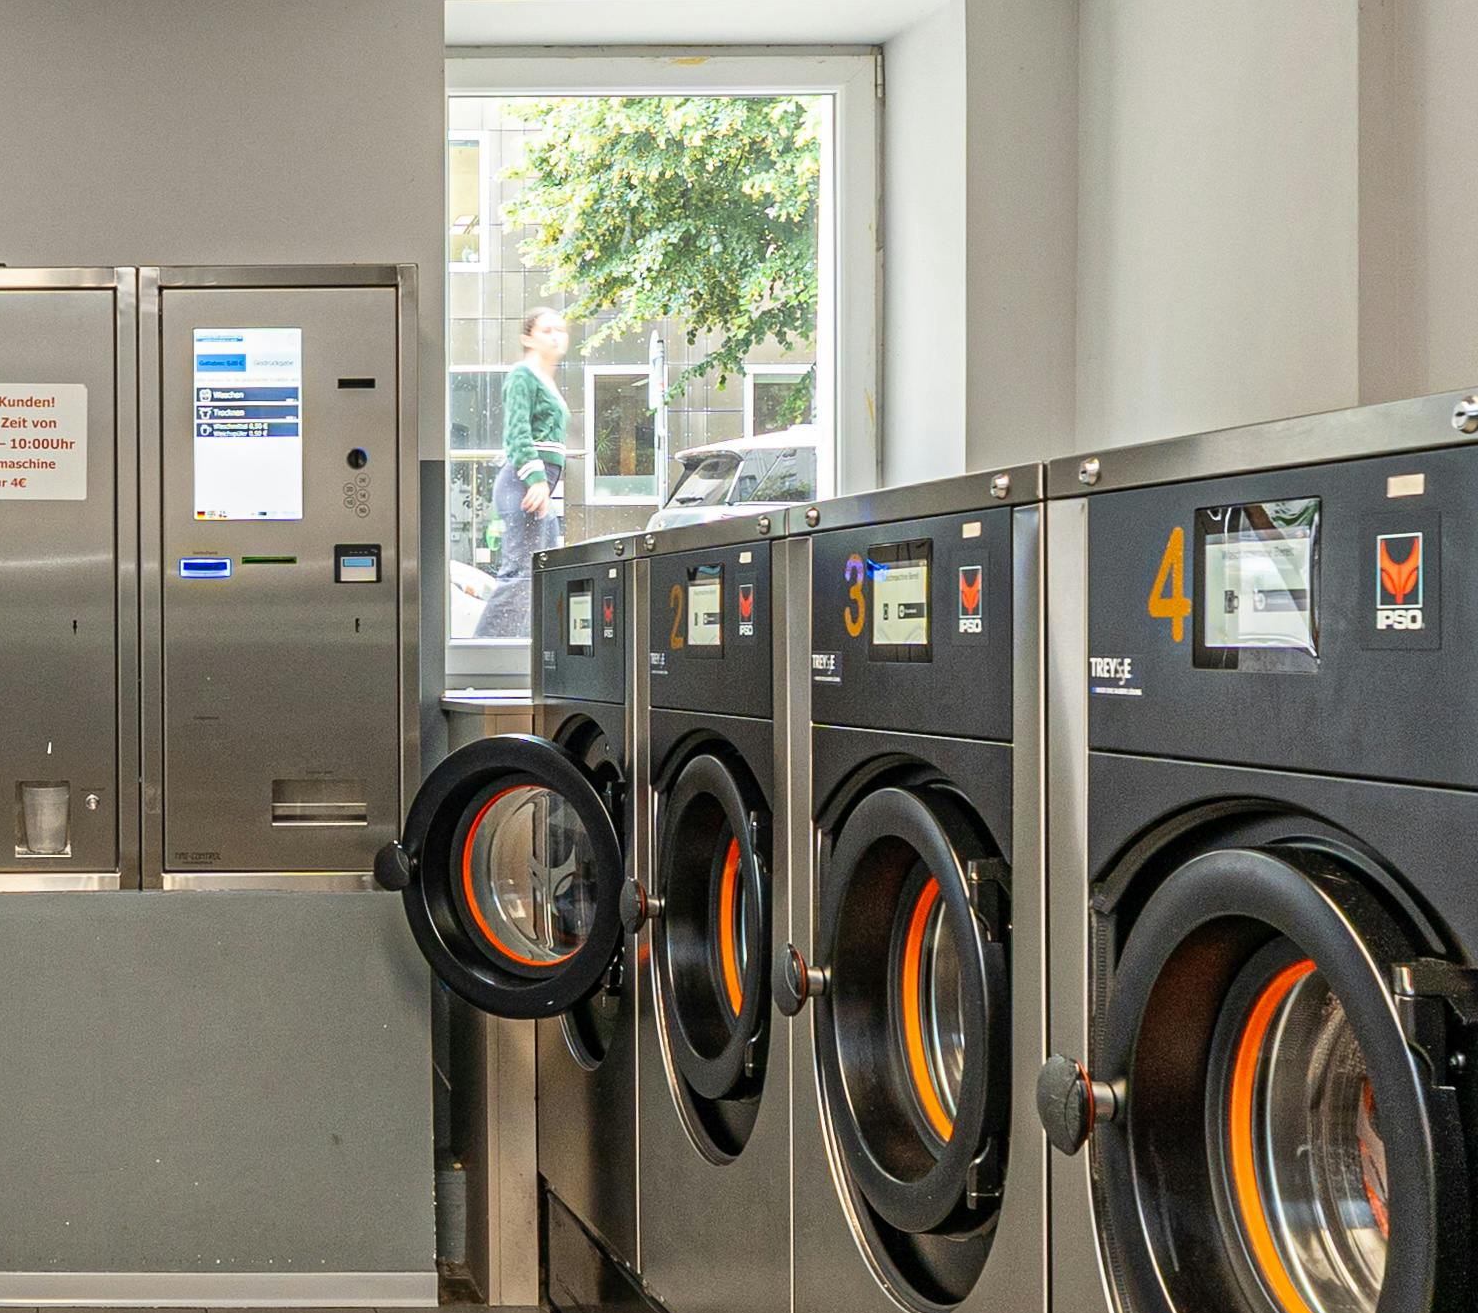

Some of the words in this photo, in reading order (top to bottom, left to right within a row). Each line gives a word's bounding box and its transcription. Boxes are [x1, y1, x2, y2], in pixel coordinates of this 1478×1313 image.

[1, 417, 28, 429] Zeit
[32, 419, 57, 429] von
[10, 438, 75, 450] 10:00Uhr
[10, 478, 27, 488] 4€
[843, 553, 866, 636] 3
[1148, 527, 1191, 642] 4
[669, 584, 684, 649] 2
[1376, 609, 1423, 630] IPSO
